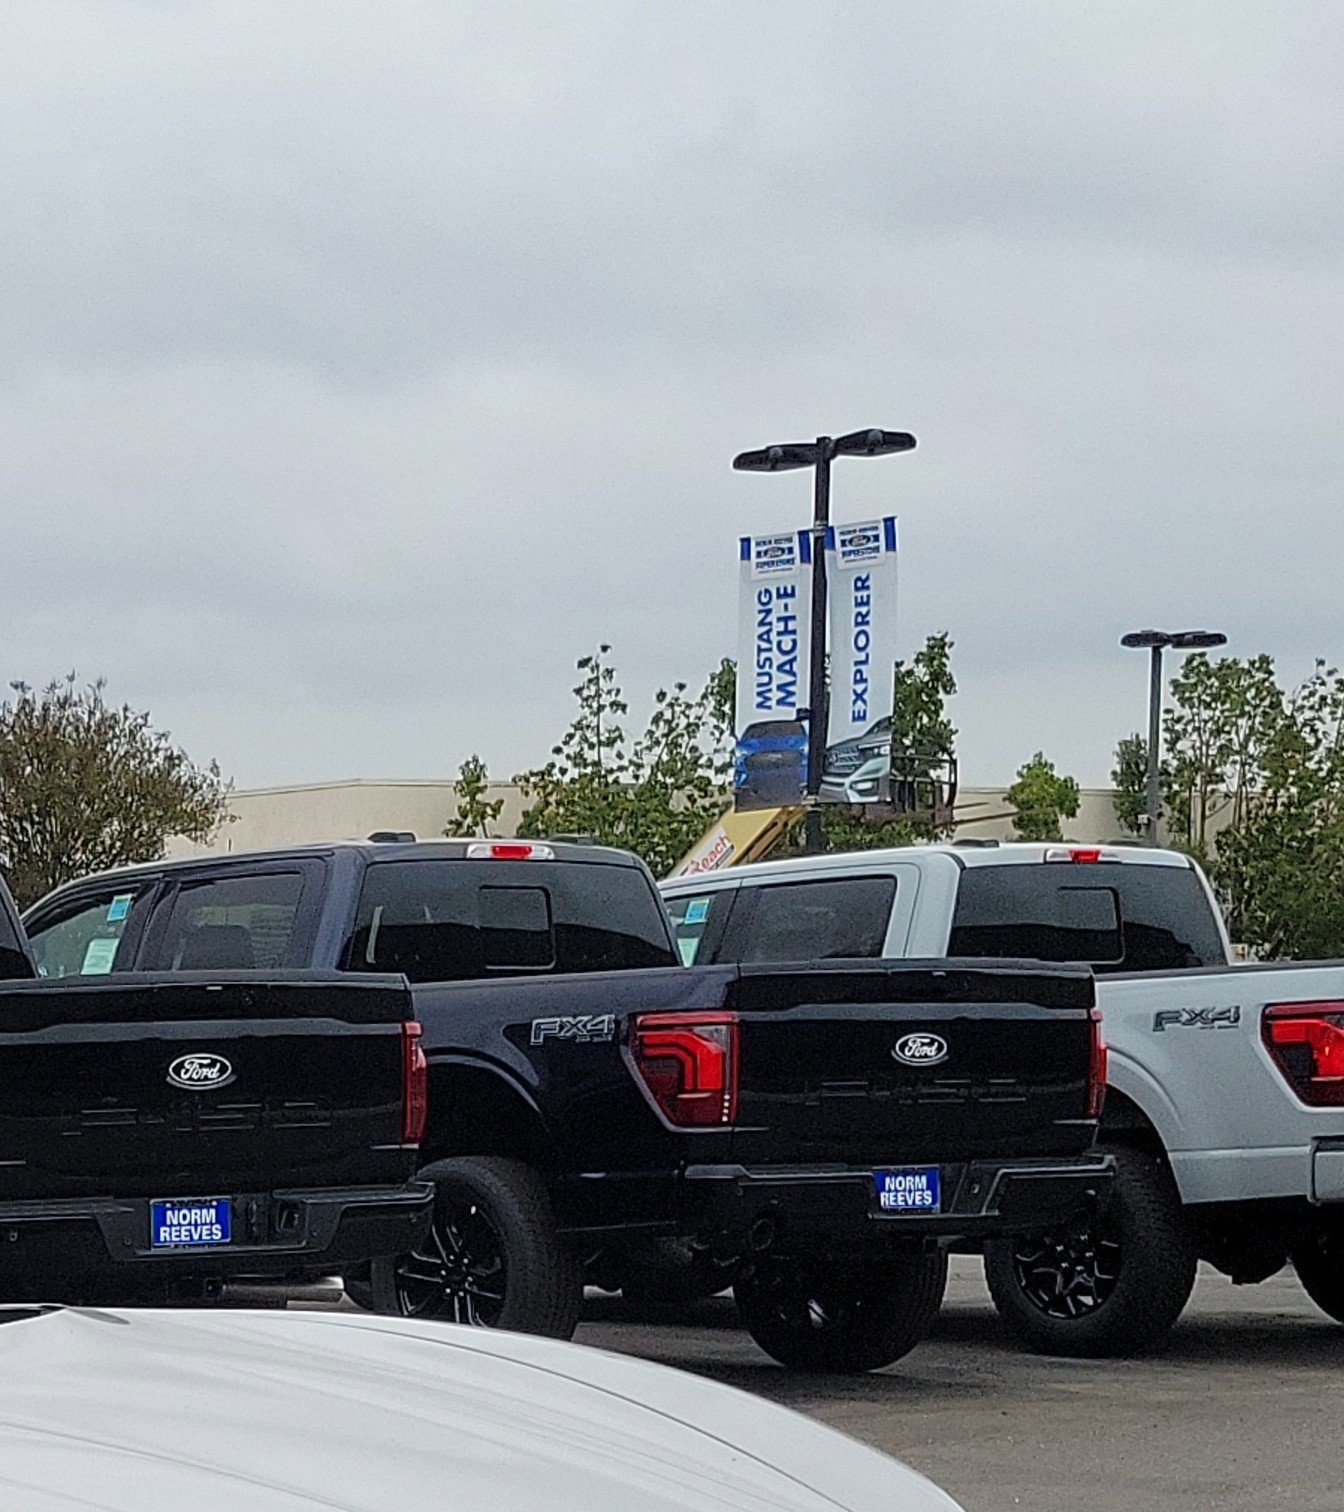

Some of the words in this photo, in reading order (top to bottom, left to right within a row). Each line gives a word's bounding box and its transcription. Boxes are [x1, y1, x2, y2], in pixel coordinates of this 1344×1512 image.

[755, 587, 773, 711] MUSTANG
[775, 585, 798, 708] MACH-E
[851, 573, 871, 723] EXPLORER
[530, 1014, 616, 1045] FX4
[1153, 1005, 1240, 1032] FX4
[904, 1038, 939, 1057] Ford
[180, 1058, 221, 1080] Ford
[884, 1175, 927, 1191] NORM
[880, 1189, 933, 1208] REEVES
[165, 1208, 216, 1225] NORM
[159, 1223, 223, 1242] REEVES
